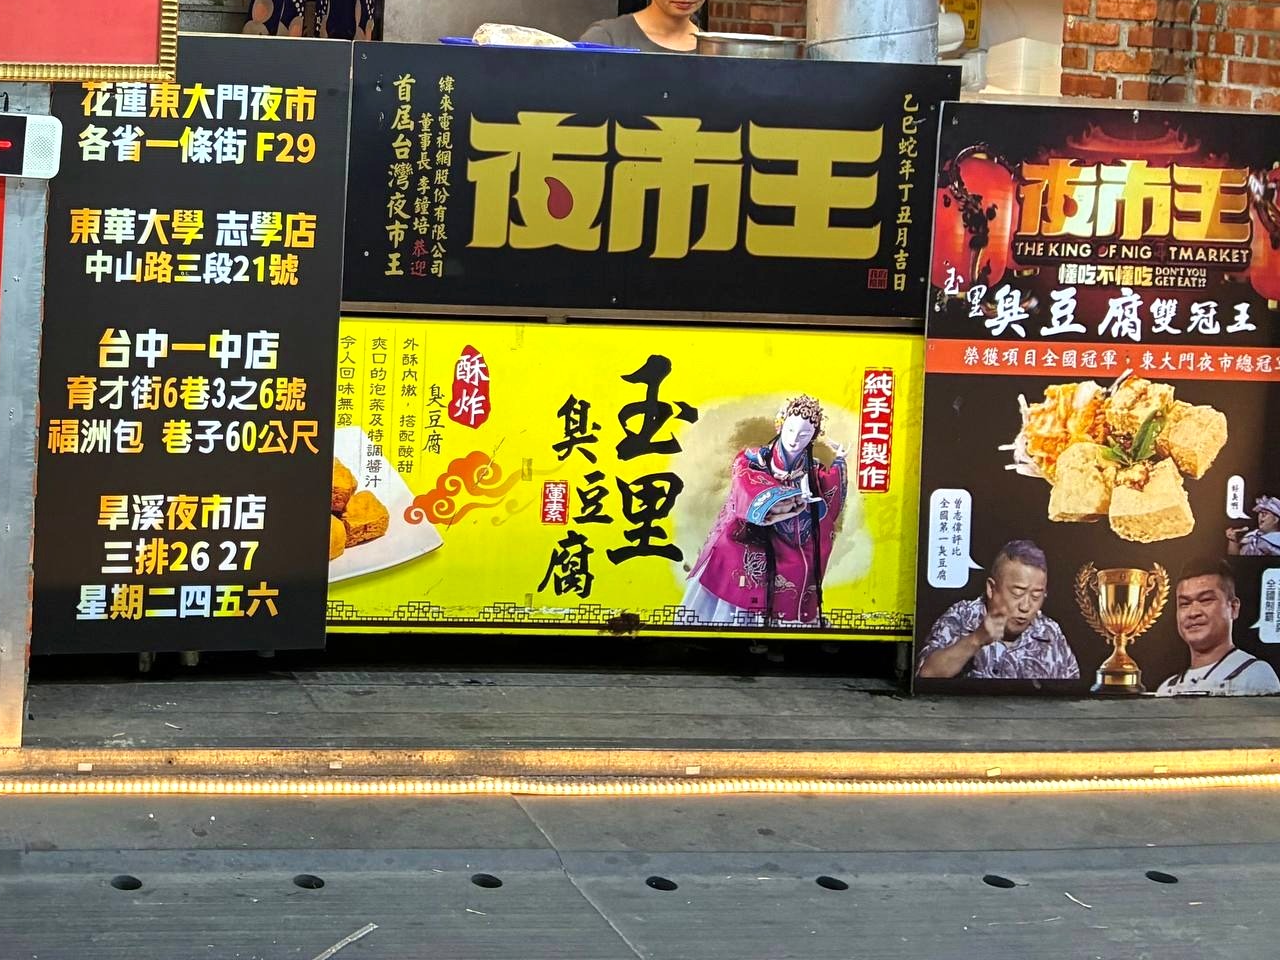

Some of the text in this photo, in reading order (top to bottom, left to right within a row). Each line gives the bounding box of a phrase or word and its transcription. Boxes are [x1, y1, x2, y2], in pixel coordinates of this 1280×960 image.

[80, 82, 317, 122] 花蓮東大門夜市
[77, 124, 316, 164] 各省一條街 F29
[384, 73, 416, 276] 首屆台灣夜市王
[430, 75, 455, 278] 緯來電視網股份有限公司
[466, 111, 888, 260] 夜市王
[894, 94, 919, 291] 乙巳蛇年丁丑月吉日
[1022, 159, 1250, 242] 夜市王
[70, 208, 317, 248] 東華大學 志學店
[85, 249, 299, 286] 中山路三段21號
[1016, 242, 1044, 255] THE
[1048, 243, 1091, 257] KING
[1058, 264, 1153, 286] 懂吃不懂吃
[1155, 276, 1177, 286] GET
[1156, 266, 1207, 278] DON'T YOU
[98, 328, 280, 370] 台中一中店
[67, 376, 307, 412] 育才街6巷3之6號
[337, 336, 357, 426] 令人回味無窮
[454, 354, 490, 425] 酥炸
[365, 336, 388, 488] 爽口的泡菜及特調醬汁
[423, 384, 447, 454] 臭豆腐
[859, 373, 892, 488] 純手工製作
[47, 419, 320, 455] 福洲包 巷子60公尺
[607, 354, 698, 566] 玉里
[97, 494, 267, 531] 旱溪夜市店
[538, 394, 613, 598] 臭豆腐
[543, 482, 566, 522] 葷素
[937, 497, 950, 580] 全國第一臭豆腐
[952, 497, 963, 556] 曾志偉評比
[101, 537, 259, 575] 三排26 27
[76, 581, 279, 620] 星期二四五六
